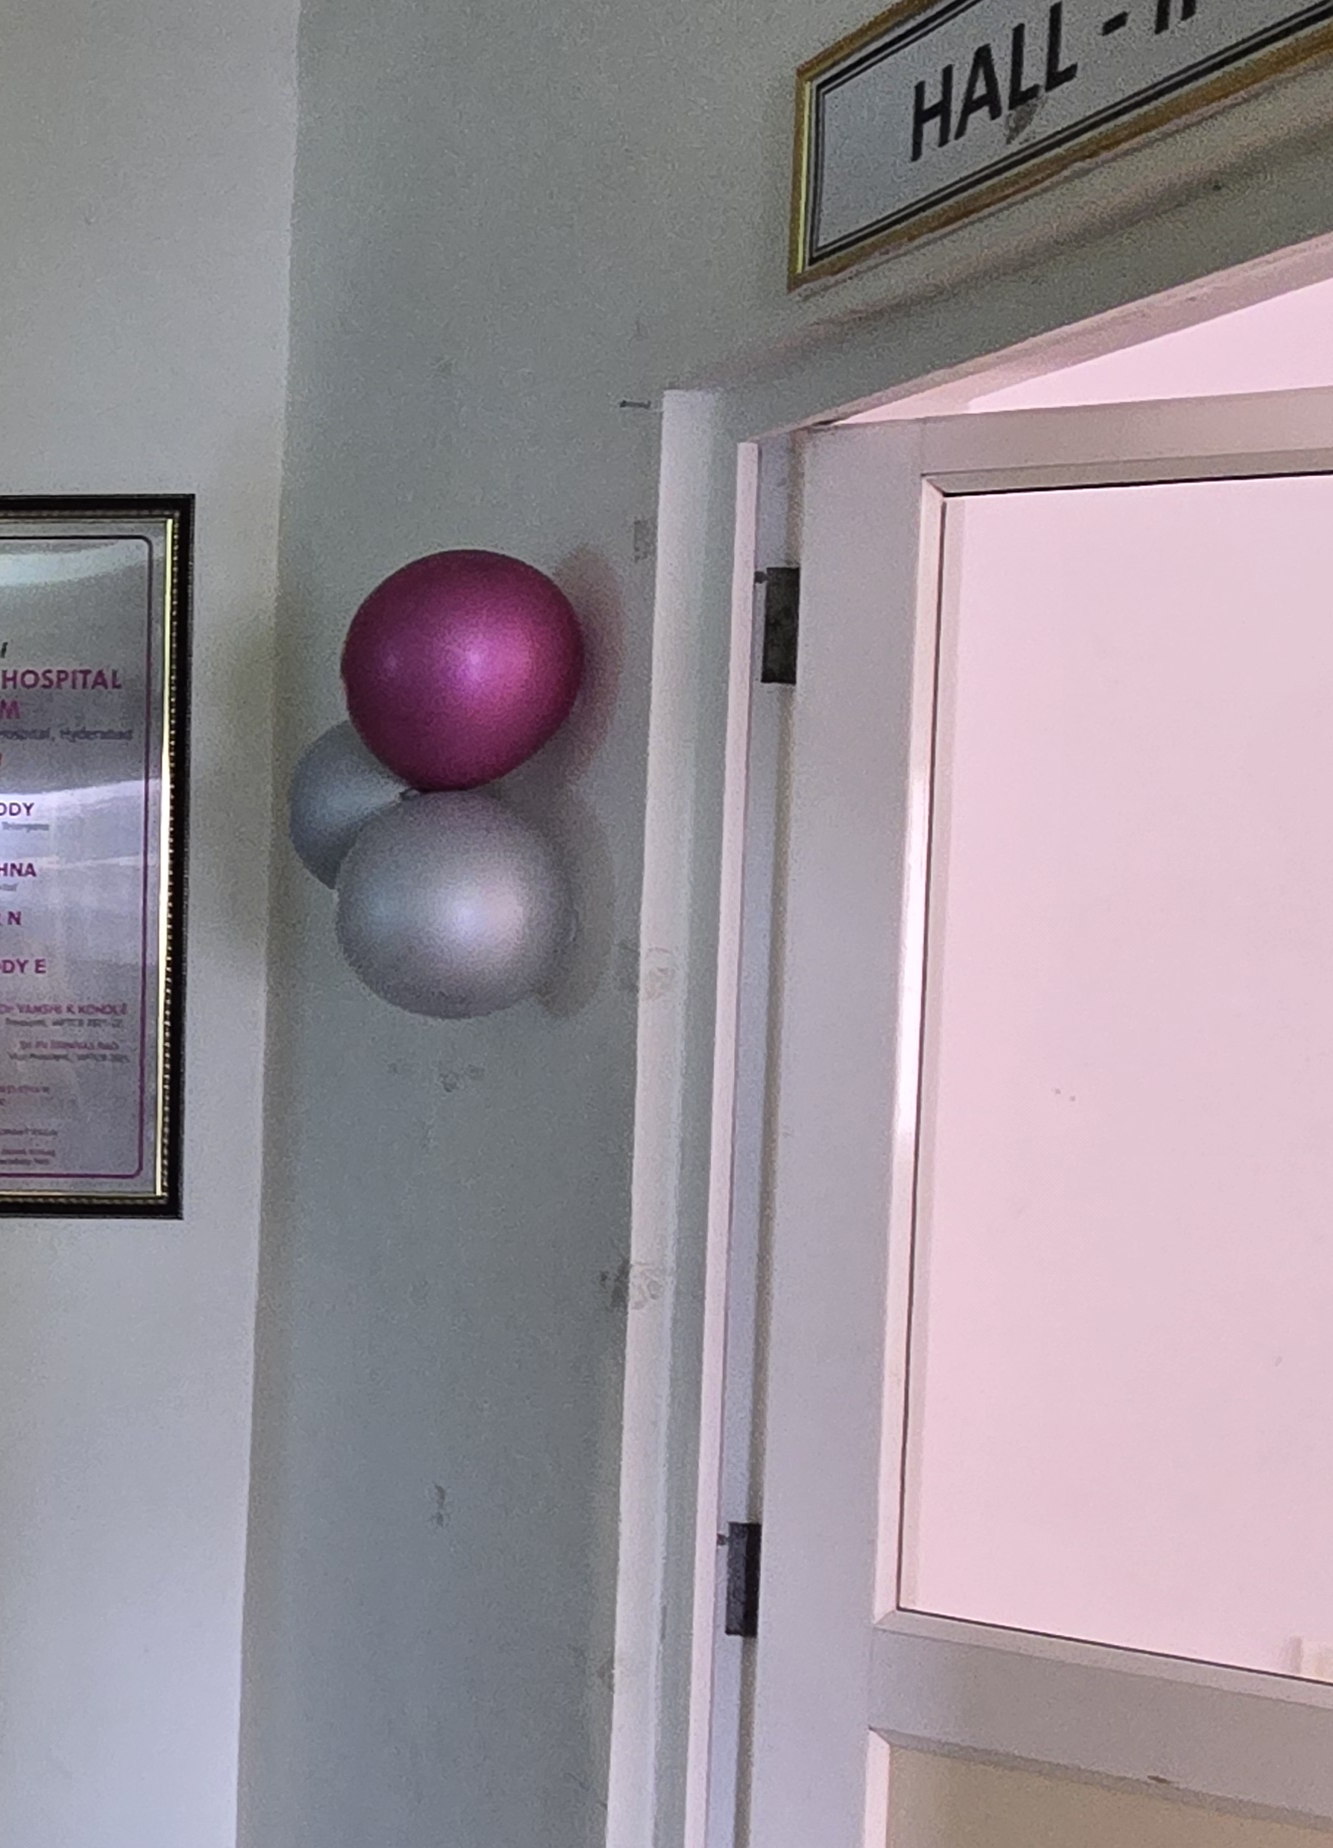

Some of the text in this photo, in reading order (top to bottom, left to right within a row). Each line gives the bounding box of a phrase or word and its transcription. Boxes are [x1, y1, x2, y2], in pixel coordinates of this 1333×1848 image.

[910, 1, 1079, 163] HALL
[1, 669, 122, 690] HOSPITAL
[7, 911, 23, 926] N
[34, 958, 47, 974] E
